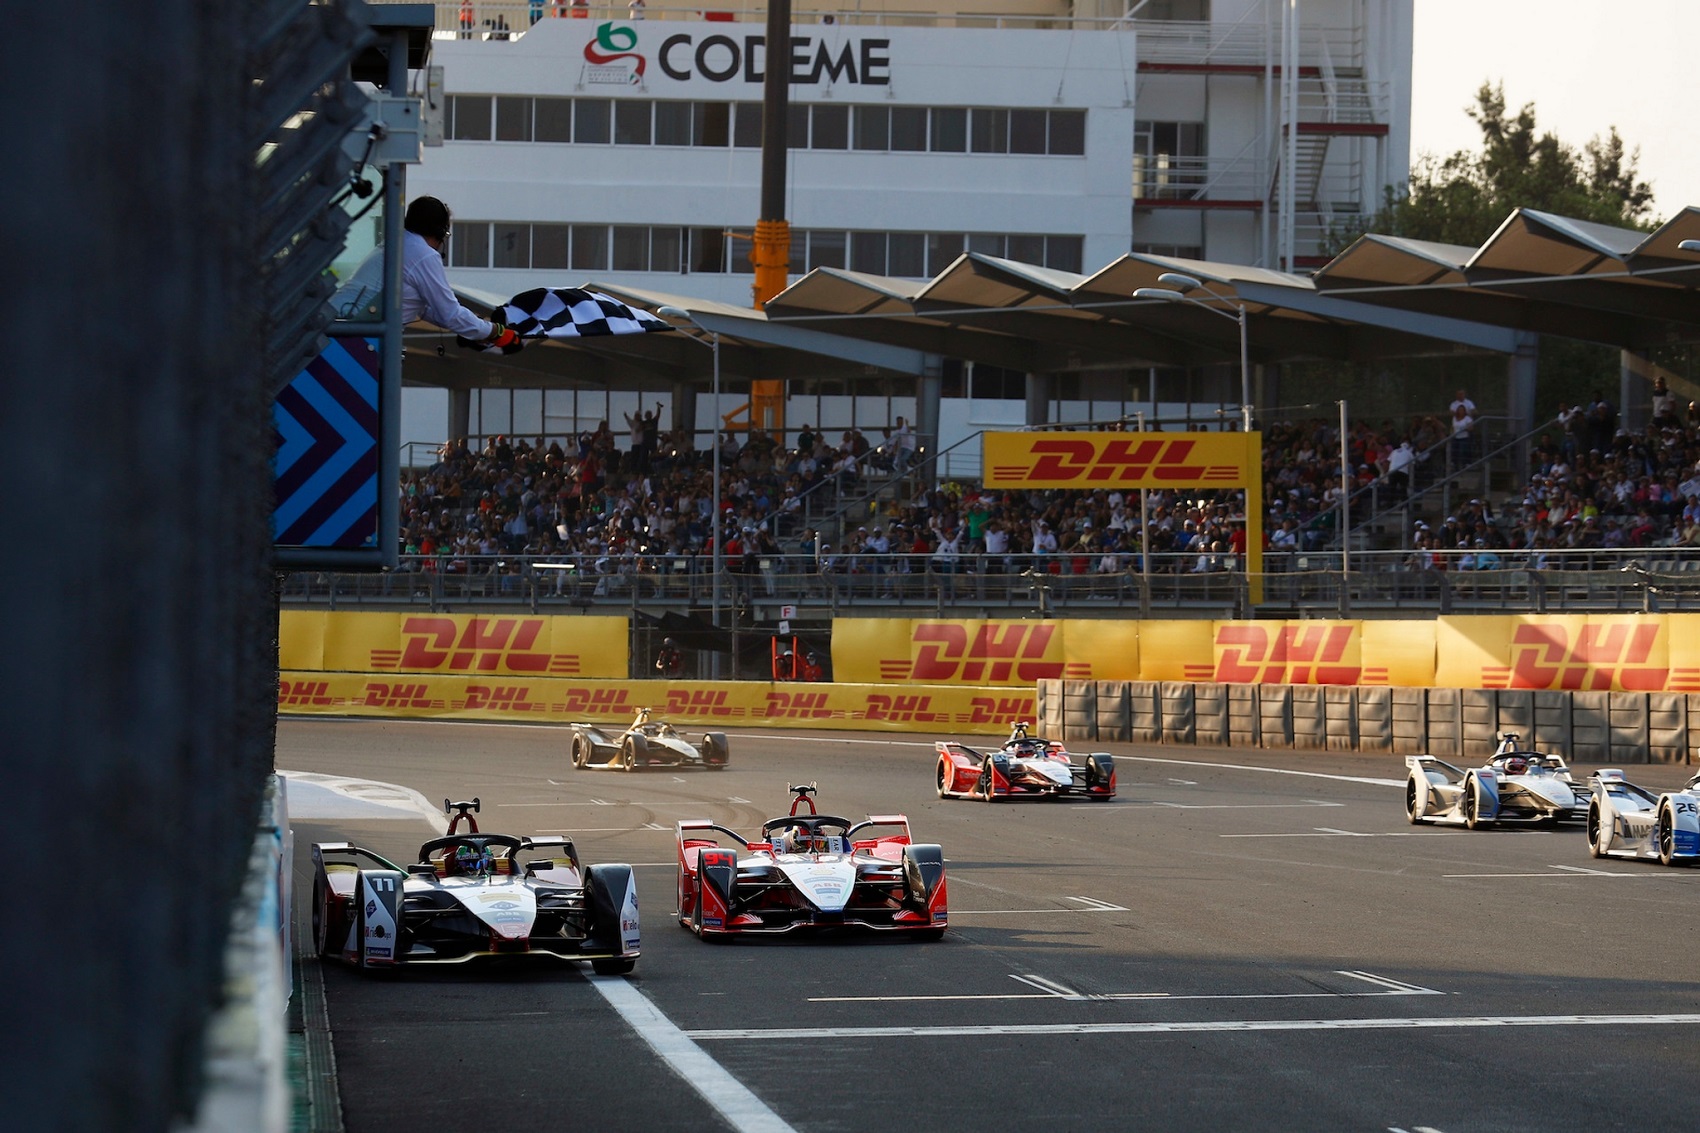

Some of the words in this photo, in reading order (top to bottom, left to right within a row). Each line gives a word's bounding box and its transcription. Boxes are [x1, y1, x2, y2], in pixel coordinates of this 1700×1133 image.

[658, 33, 890, 85] CODEME
[1026, 440, 1206, 480] DHL
[783, 607, 791, 618] F
[401, 618, 551, 671] DHL
[913, 624, 1062, 681] DHL
[1214, 625, 1361, 685] DHL
[1509, 623, 1668, 690] DHL
[364, 683, 432, 709] DHL
[464, 686, 533, 711] DHL
[565, 688, 634, 714] DHL
[664, 690, 732, 716] DHL
[763, 692, 832, 719] DHL
[864, 694, 935, 722] DHL
[969, 697, 1037, 725] DHL
[704, 853, 734, 868] 94
[372, 877, 395, 892] 11
